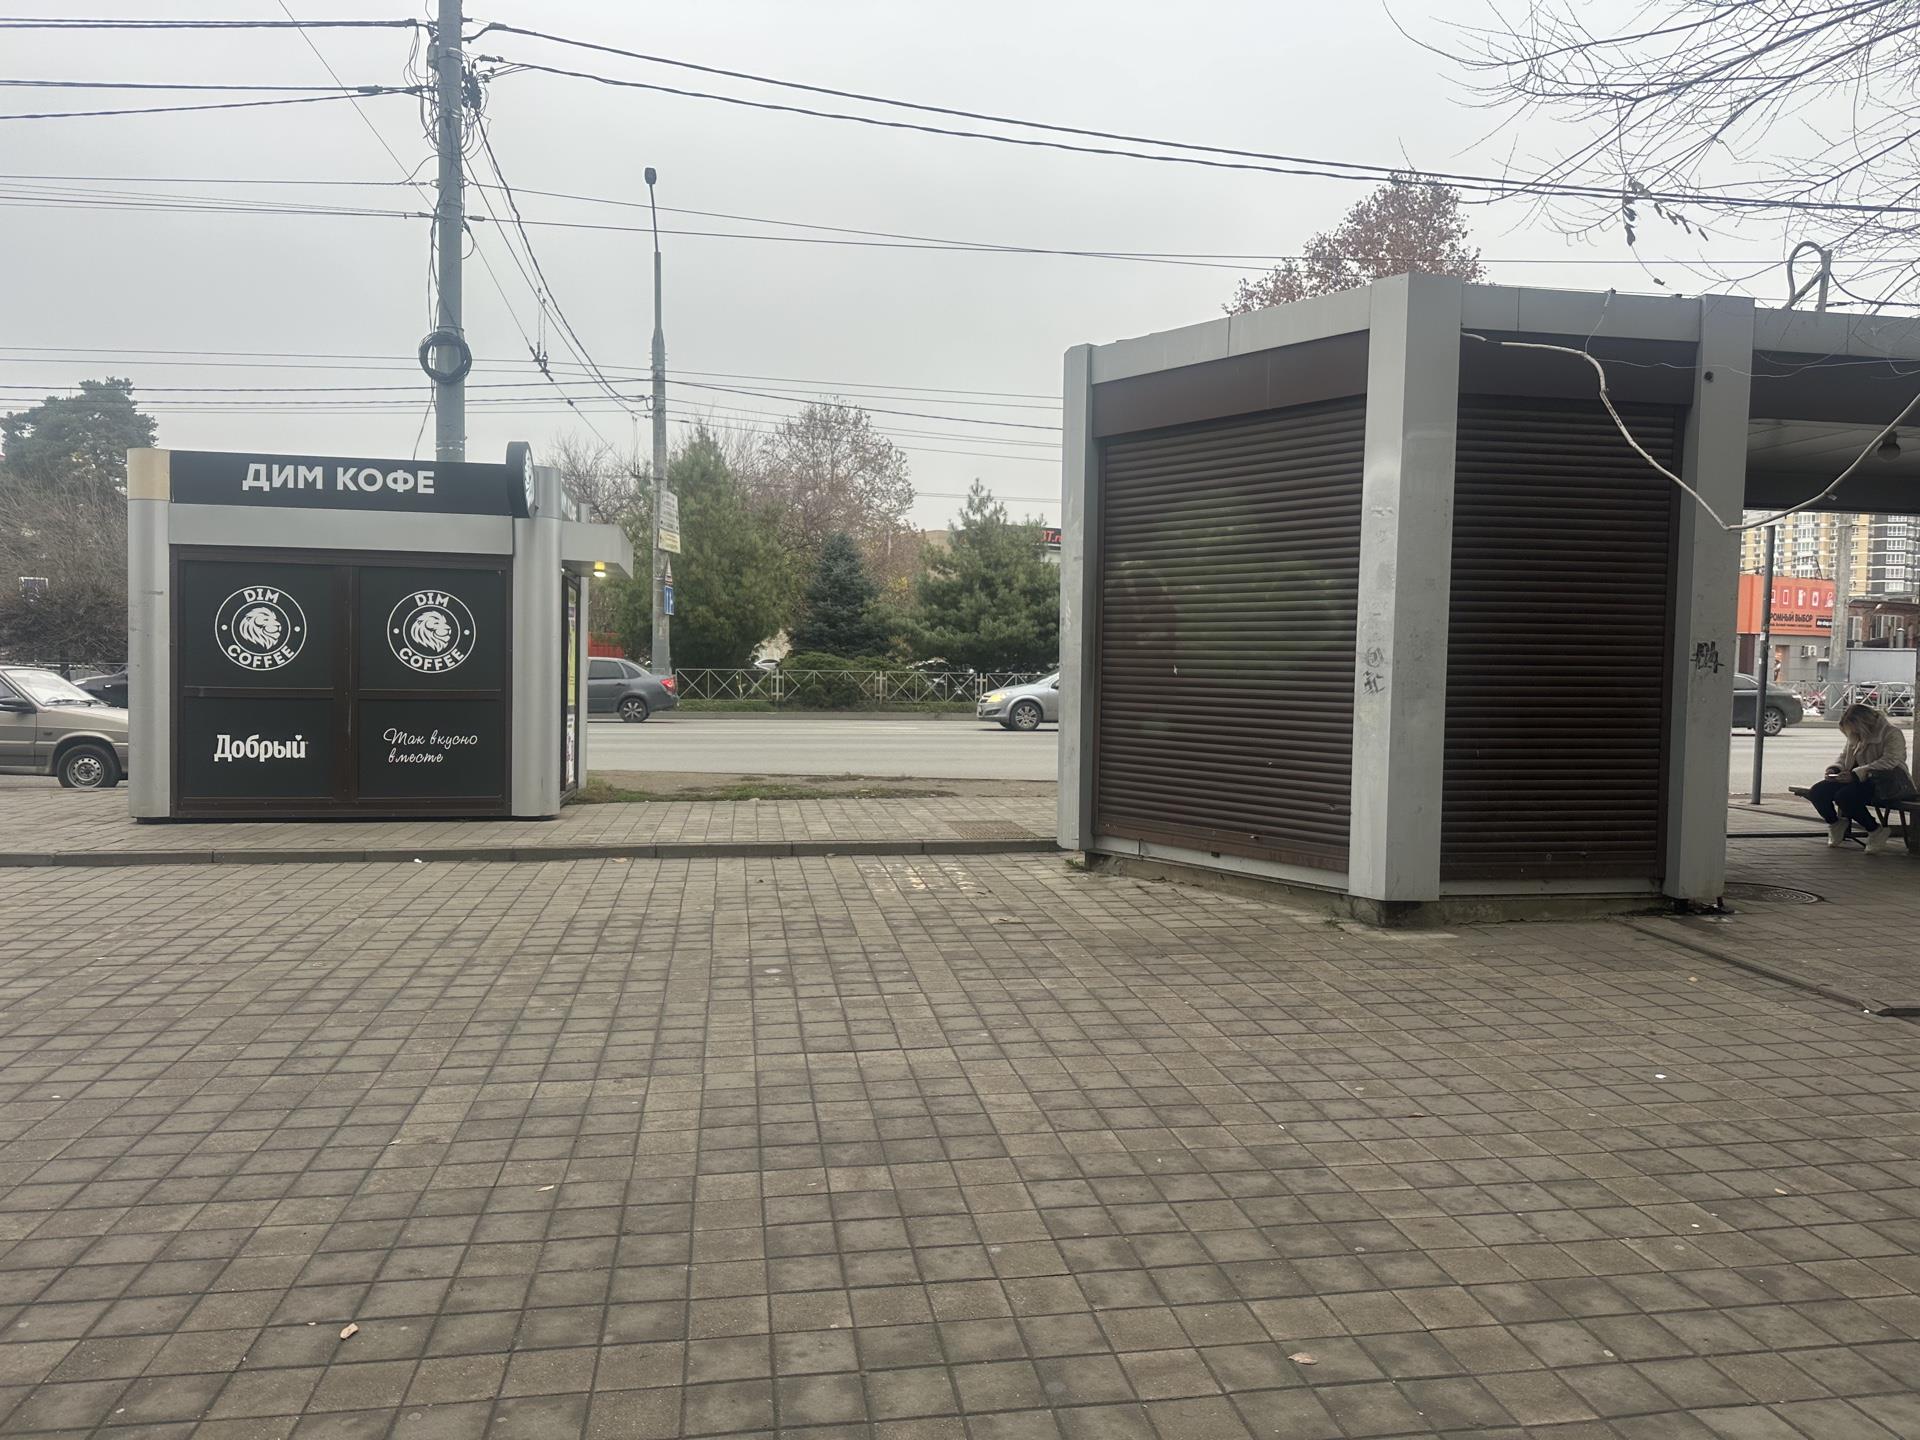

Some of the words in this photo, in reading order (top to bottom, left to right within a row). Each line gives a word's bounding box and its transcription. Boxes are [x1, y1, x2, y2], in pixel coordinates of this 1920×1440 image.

[242, 463, 324, 492] ДИМ
[336, 467, 435, 494] КОФЕ
[243, 588, 279, 604] DIM
[414, 592, 450, 608] DIM
[227, 644, 295, 668] COFFEE
[399, 647, 465, 671] COFFEE
[213, 733, 306, 763] Добрый
[382, 727, 426, 746] Так
[429, 729, 479, 750] вкусно
[388, 747, 444, 764] вместе
